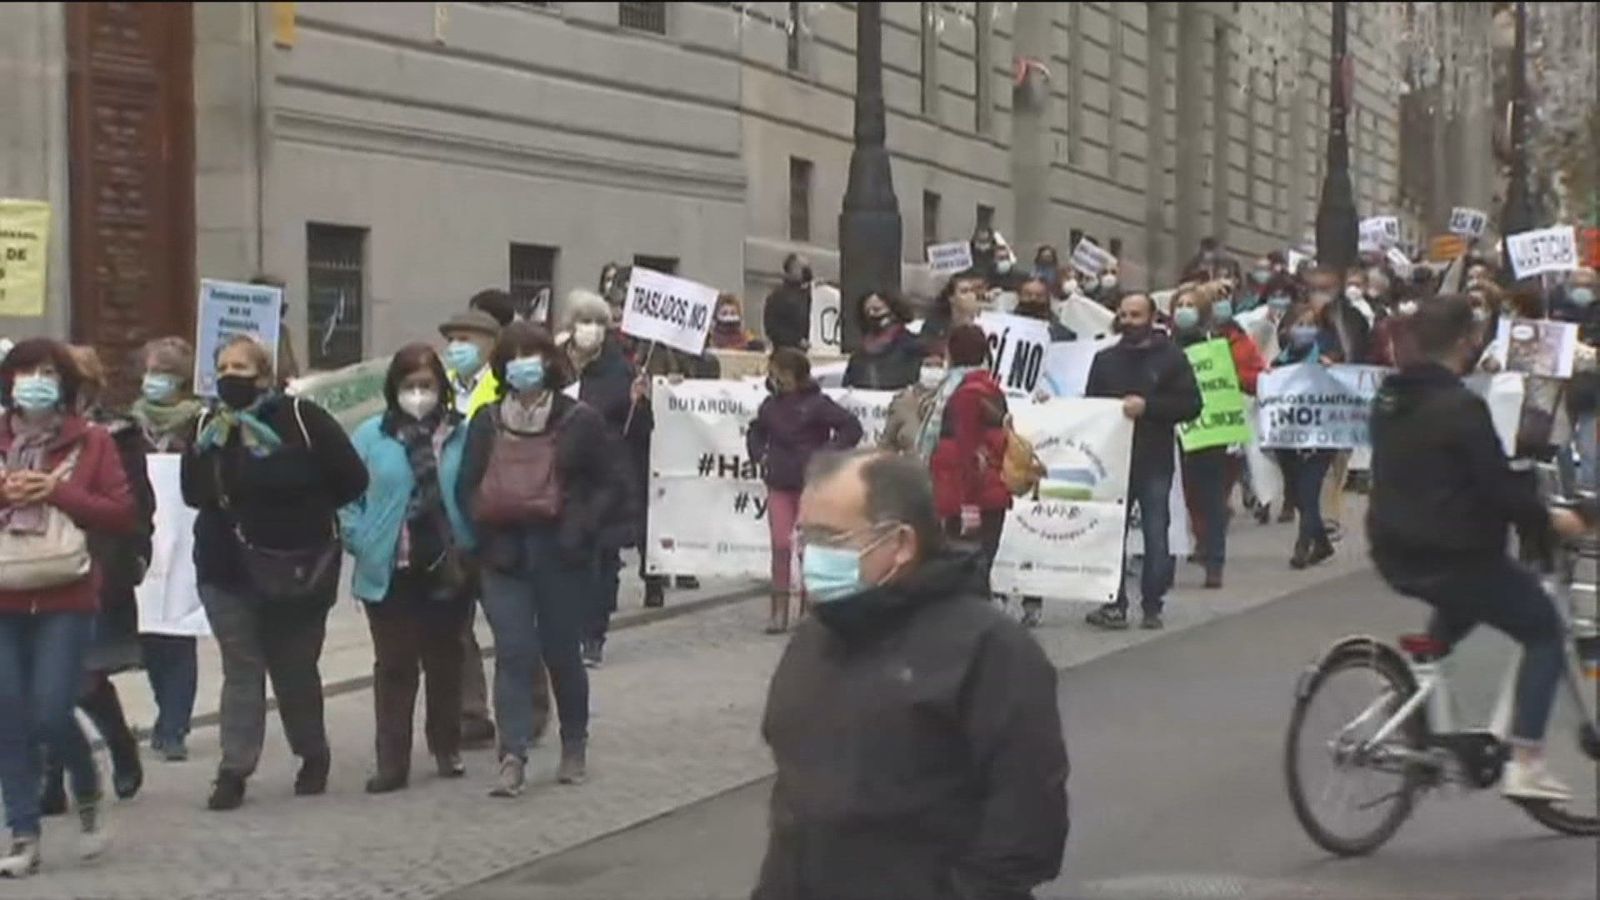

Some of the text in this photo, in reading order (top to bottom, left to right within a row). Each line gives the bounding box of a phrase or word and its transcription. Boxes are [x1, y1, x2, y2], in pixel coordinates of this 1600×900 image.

[7, 247, 27, 261] DE
[1007, 339, 1044, 394] NO
[1270, 407, 1321, 427] ¡NO!
[698, 453, 765, 480] #Ha
